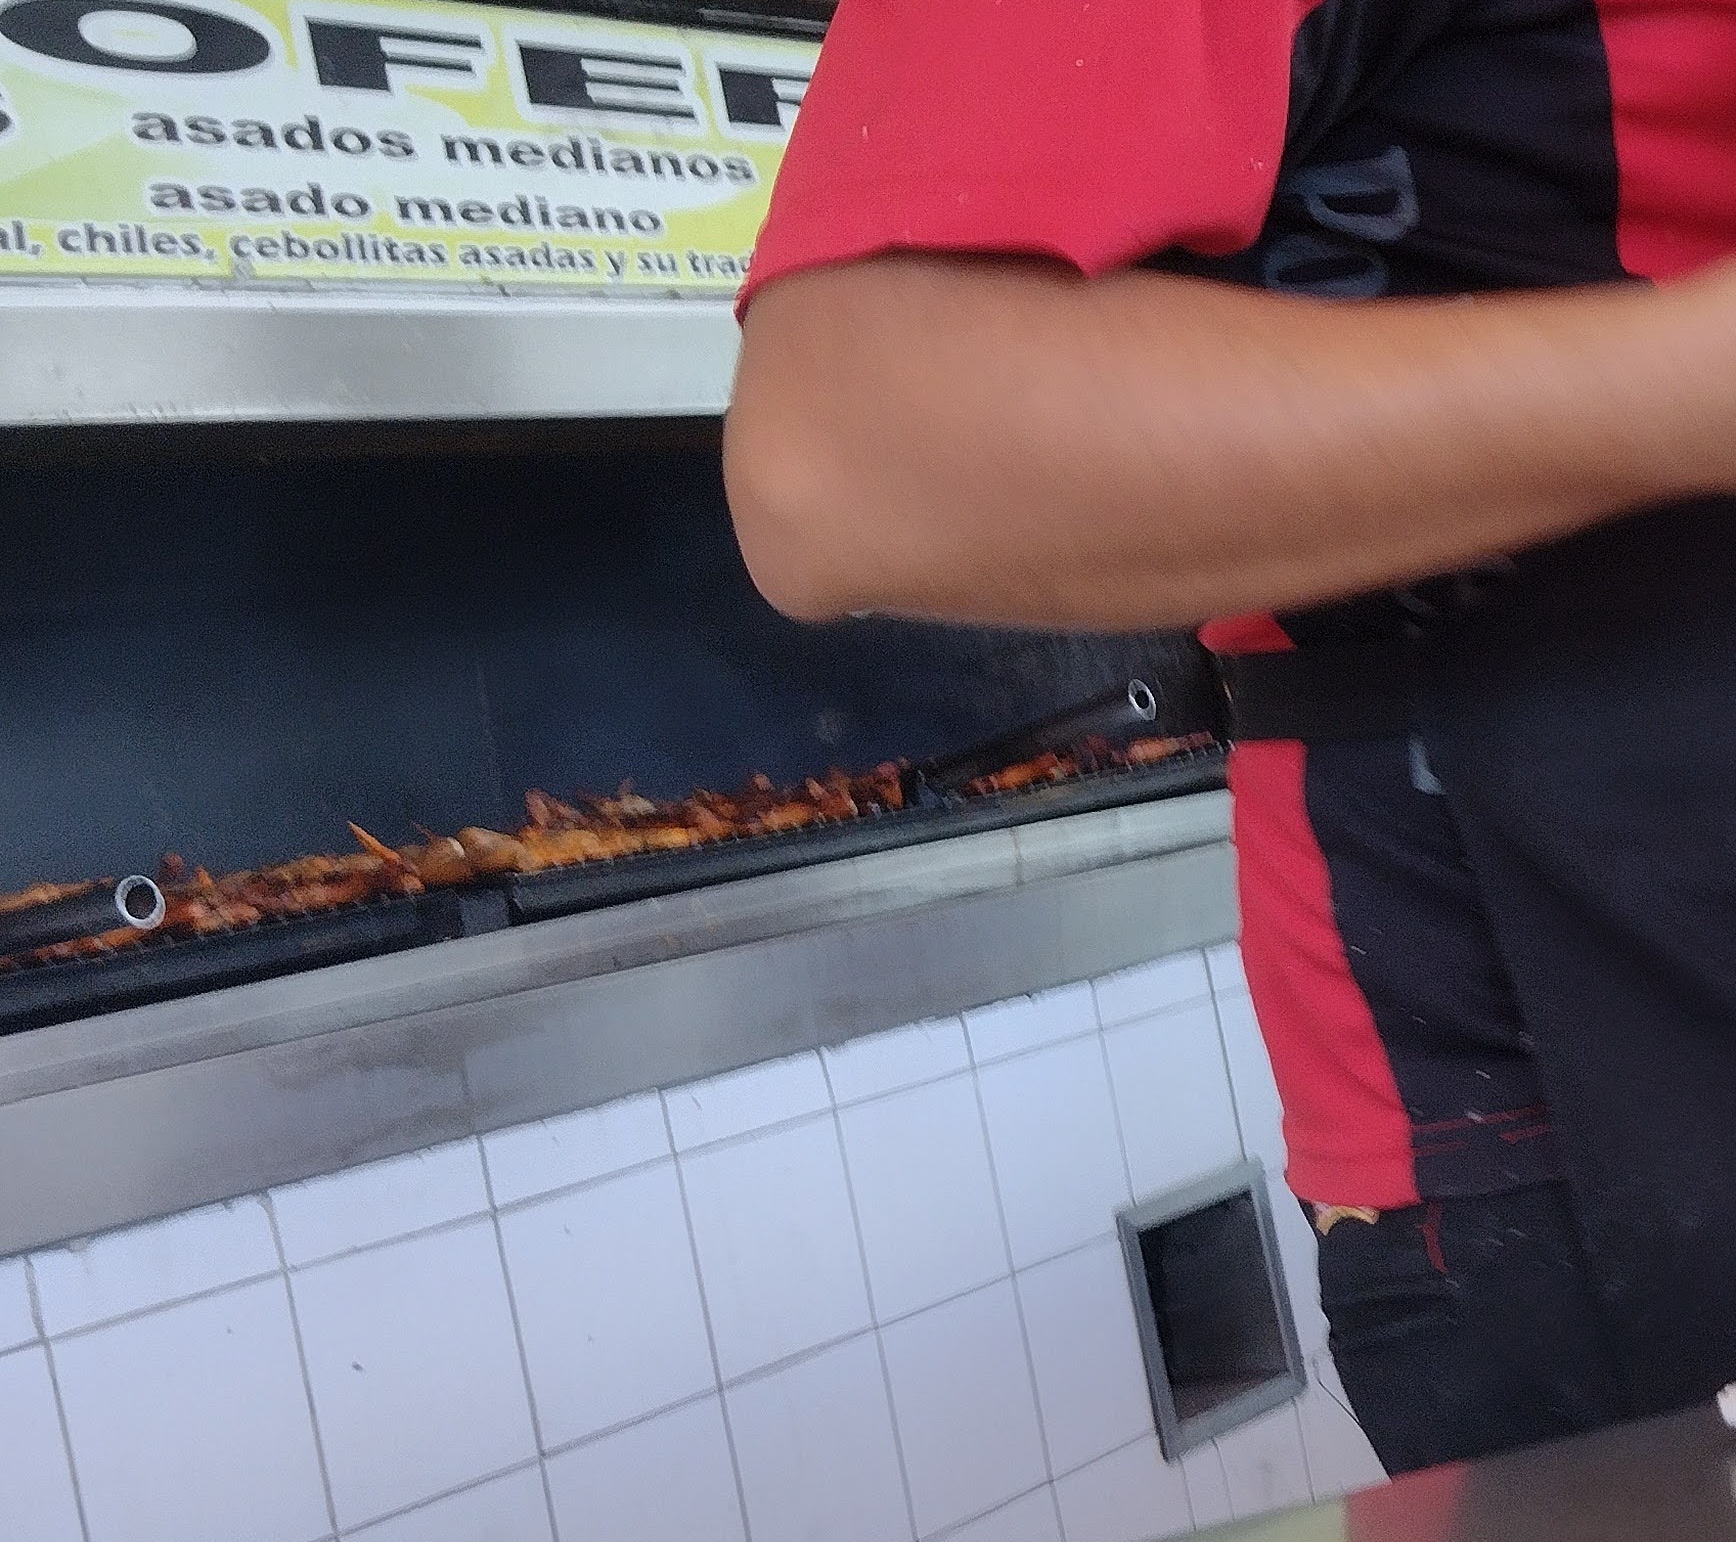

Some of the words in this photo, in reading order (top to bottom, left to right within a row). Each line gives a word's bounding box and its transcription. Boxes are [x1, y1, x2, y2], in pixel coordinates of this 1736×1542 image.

[132, 111, 417, 158] asados
[441, 133, 757, 184] medianos
[149, 181, 371, 219] asado
[394, 193, 664, 235] mediano
[57, 222, 217, 265] chiles,
[229, 229, 447, 266] cebollitas
[458, 242, 597, 272] asadas
[603, 249, 627, 282] y
[637, 251, 680, 275] su
